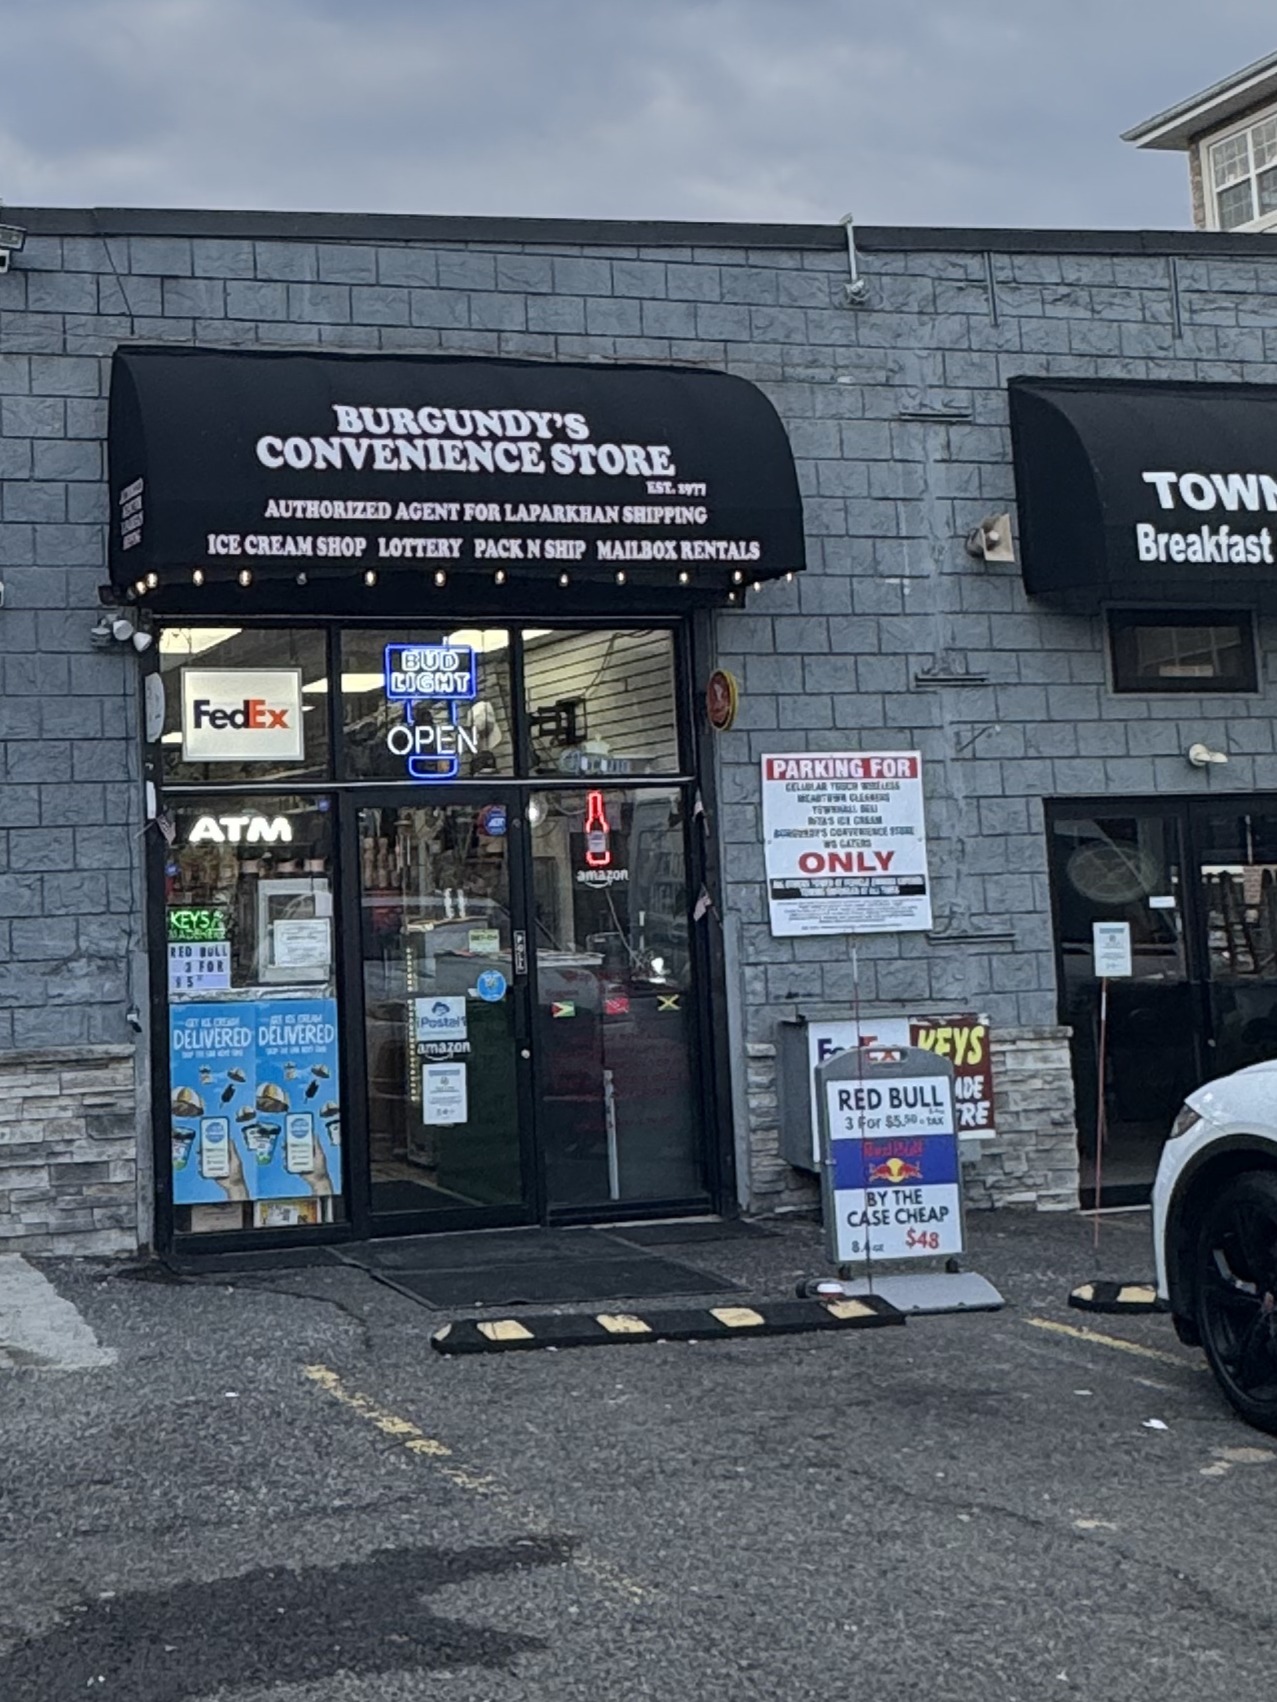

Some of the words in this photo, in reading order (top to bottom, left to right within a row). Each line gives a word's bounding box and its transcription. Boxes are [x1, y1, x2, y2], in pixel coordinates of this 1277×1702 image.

[333, 404, 590, 440] BURGUNDY'S
[256, 434, 545, 474] CONVENIENCE
[551, 443, 676, 477] STORE
[645, 481, 676, 495] EST.
[265, 499, 391, 519] AUTHORIZED
[395, 501, 460, 521] AGENT
[463, 503, 501, 522] FOR
[504, 503, 620, 524] LAPARKHAN
[622, 506, 708, 525] SHIPPING
[207, 533, 242, 555] ICE
[244, 534, 313, 556] CREAM
[316, 536, 367, 557] SHOP
[378, 537, 463, 558] LOTTERY
[474, 538, 522, 558] PACK
[526, 539, 542, 558] N
[544, 539, 586, 559] SHIP
[597, 540, 677, 560] MAILBOX
[680, 540, 760, 560] RENTALS
[1136, 523, 1274, 564] Breakfast
[401, 650, 460, 671] BUD
[390, 672, 472, 693] LIGHT
[193, 699, 290, 729] FedEx
[387, 725, 479, 754] OPEN
[773, 758, 864, 779] PARKING
[870, 757, 911, 777] FOR
[188, 815, 293, 843] ATM
[798, 850, 895, 873] ONLY
[576, 869, 629, 883] amazon
[170, 911, 210, 929] KEYS
[171, 946, 192, 958] RED
[200, 945, 227, 958] BULL
[199, 960, 224, 973] FOR
[173, 1027, 251, 1050] DELIVERED
[259, 1024, 335, 1046] DELIVERED
[918, 1026, 985, 1066] KEYS
[417, 1040, 471, 1055] amazon
[838, 1088, 882, 1111] RED
[888, 1085, 944, 1108] BULL
[955, 1075, 985, 1100] ADE
[844, 1116, 854, 1130] 3
[956, 1101, 991, 1127] RE
[866, 1190, 888, 1207] BY
[892, 1188, 923, 1206] THE
[847, 1209, 891, 1227] CASE
[895, 1206, 949, 1224] CHEAP
[905, 1226, 940, 1250] $48
